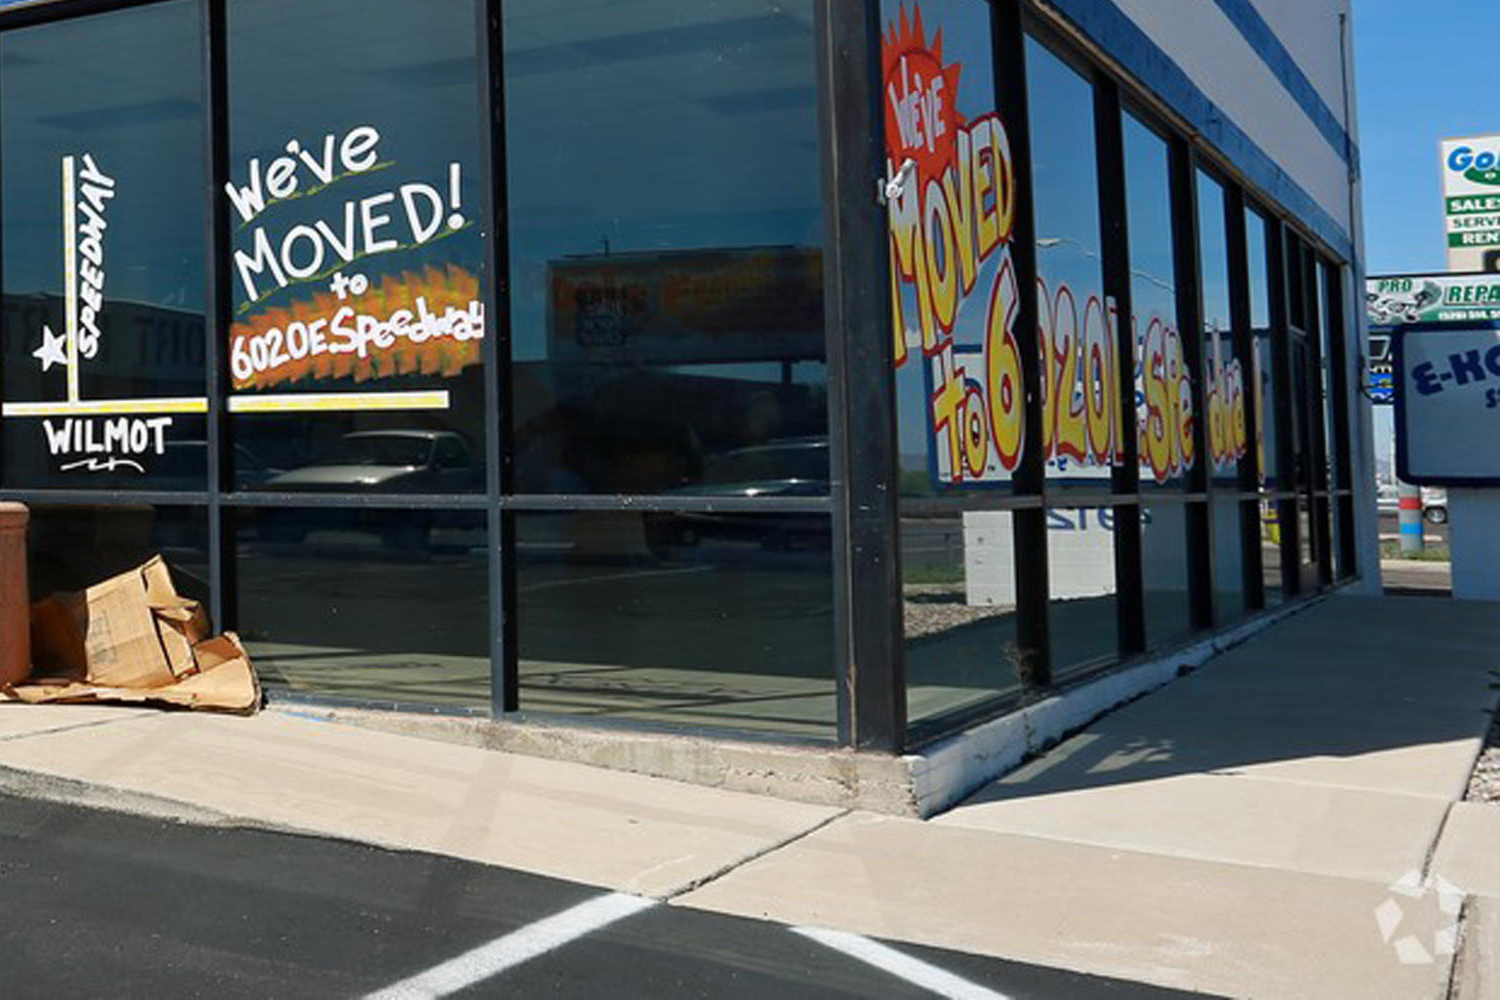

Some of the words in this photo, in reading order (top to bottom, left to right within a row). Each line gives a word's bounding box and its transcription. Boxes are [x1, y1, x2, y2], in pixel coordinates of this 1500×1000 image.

[225, 126, 380, 224] We've
[235, 162, 463, 302] MOVED!
[78, 153, 116, 359] SPEEDWAY
[329, 271, 369, 301] to
[889, 113, 1015, 368] MOVED
[43, 416, 173, 455] WILMOT
